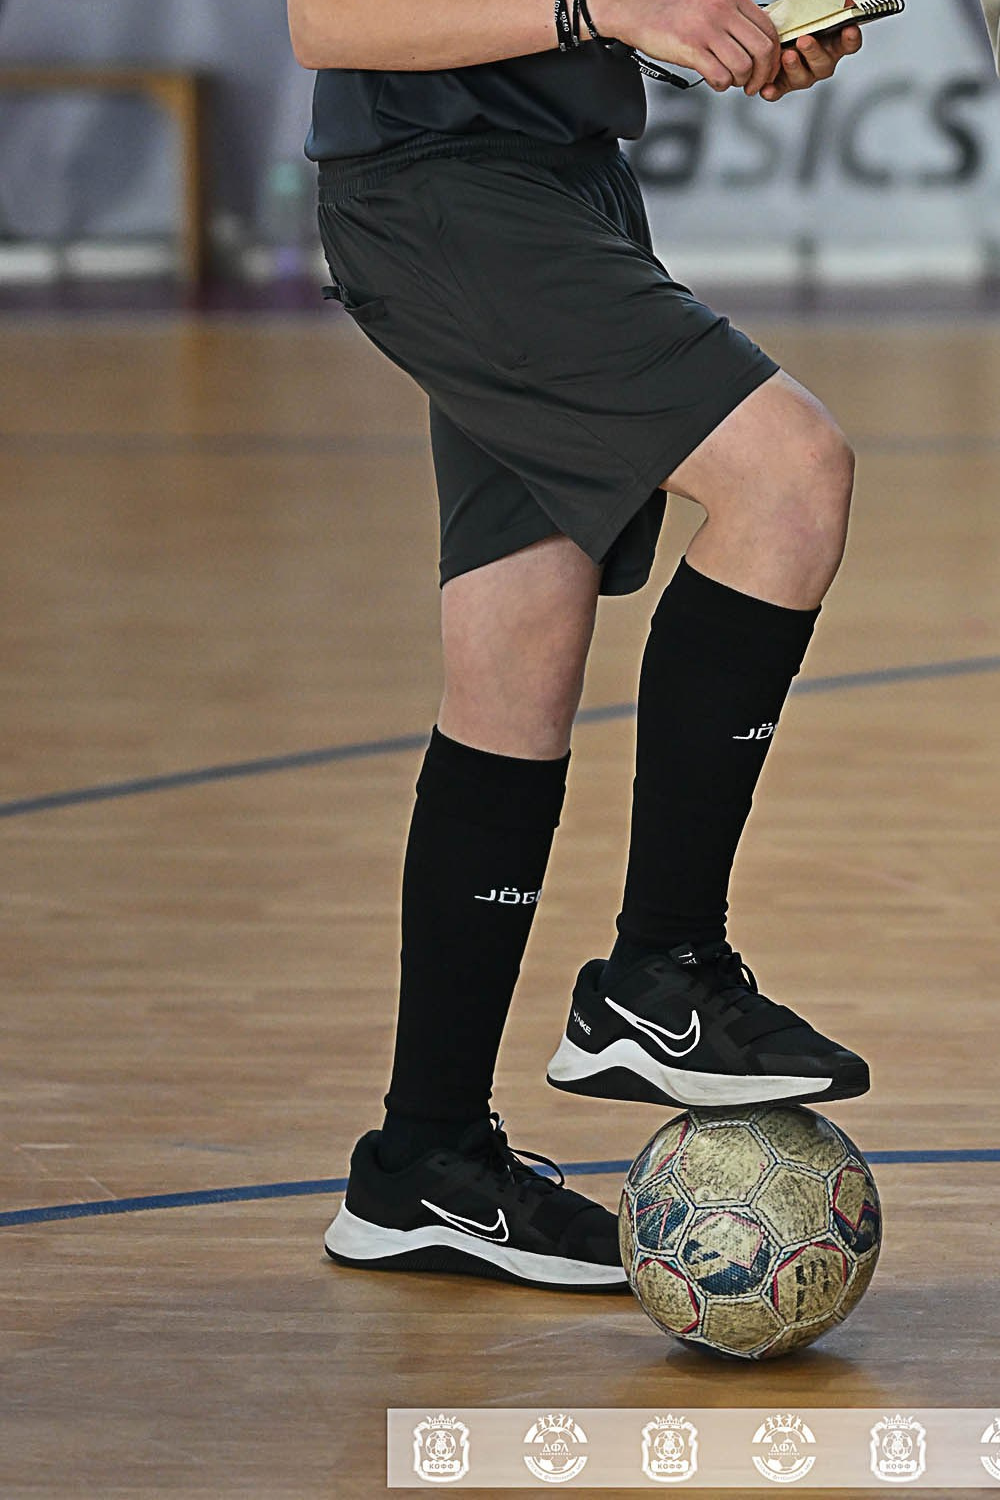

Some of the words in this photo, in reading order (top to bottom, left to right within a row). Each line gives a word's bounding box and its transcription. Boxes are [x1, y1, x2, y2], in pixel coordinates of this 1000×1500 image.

[634, 76, 984, 187] asics
[732, 722, 778, 740] JÖ
[474, 887, 542, 904] JÖG
